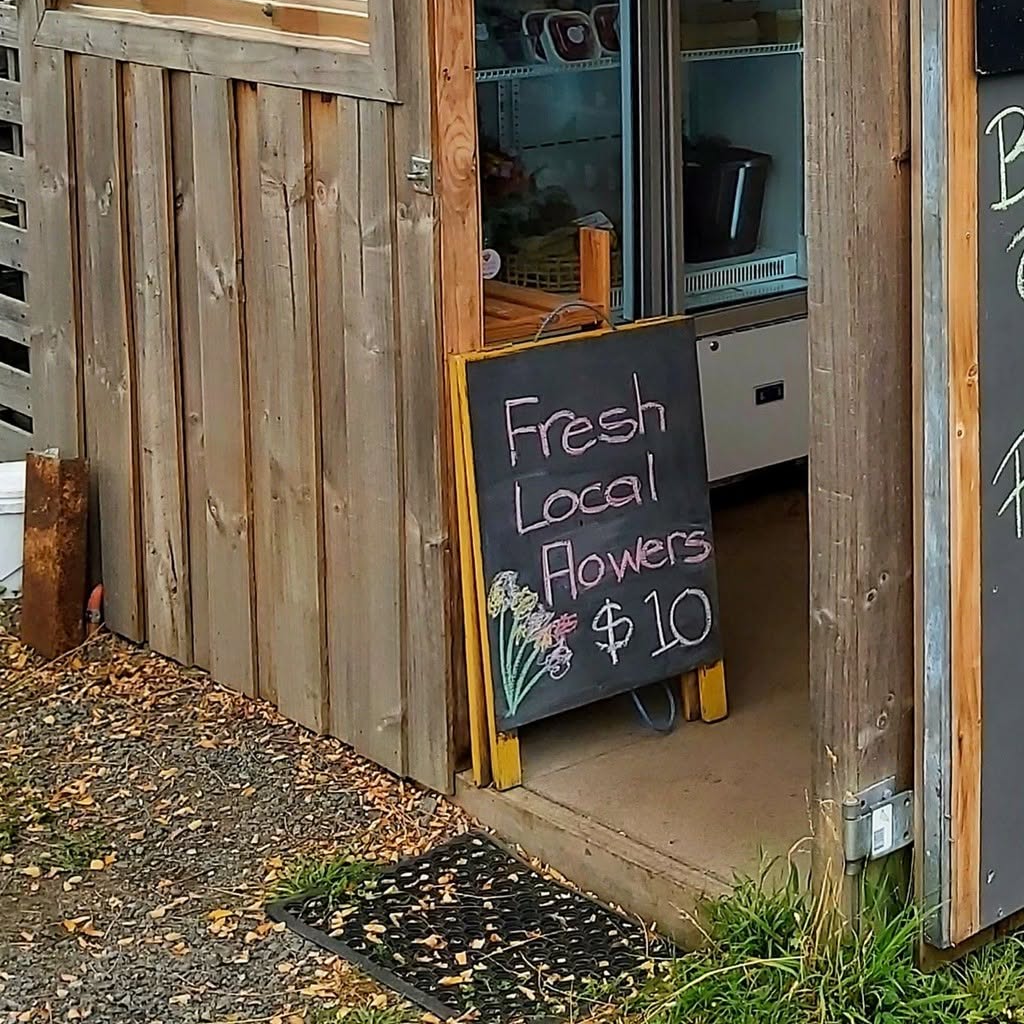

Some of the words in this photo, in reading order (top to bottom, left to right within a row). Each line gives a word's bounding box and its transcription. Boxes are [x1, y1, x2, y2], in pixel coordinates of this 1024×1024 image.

[504, 372, 666, 467] Fresh
[514, 451, 659, 536] Local
[542, 529, 715, 607] Flowers
